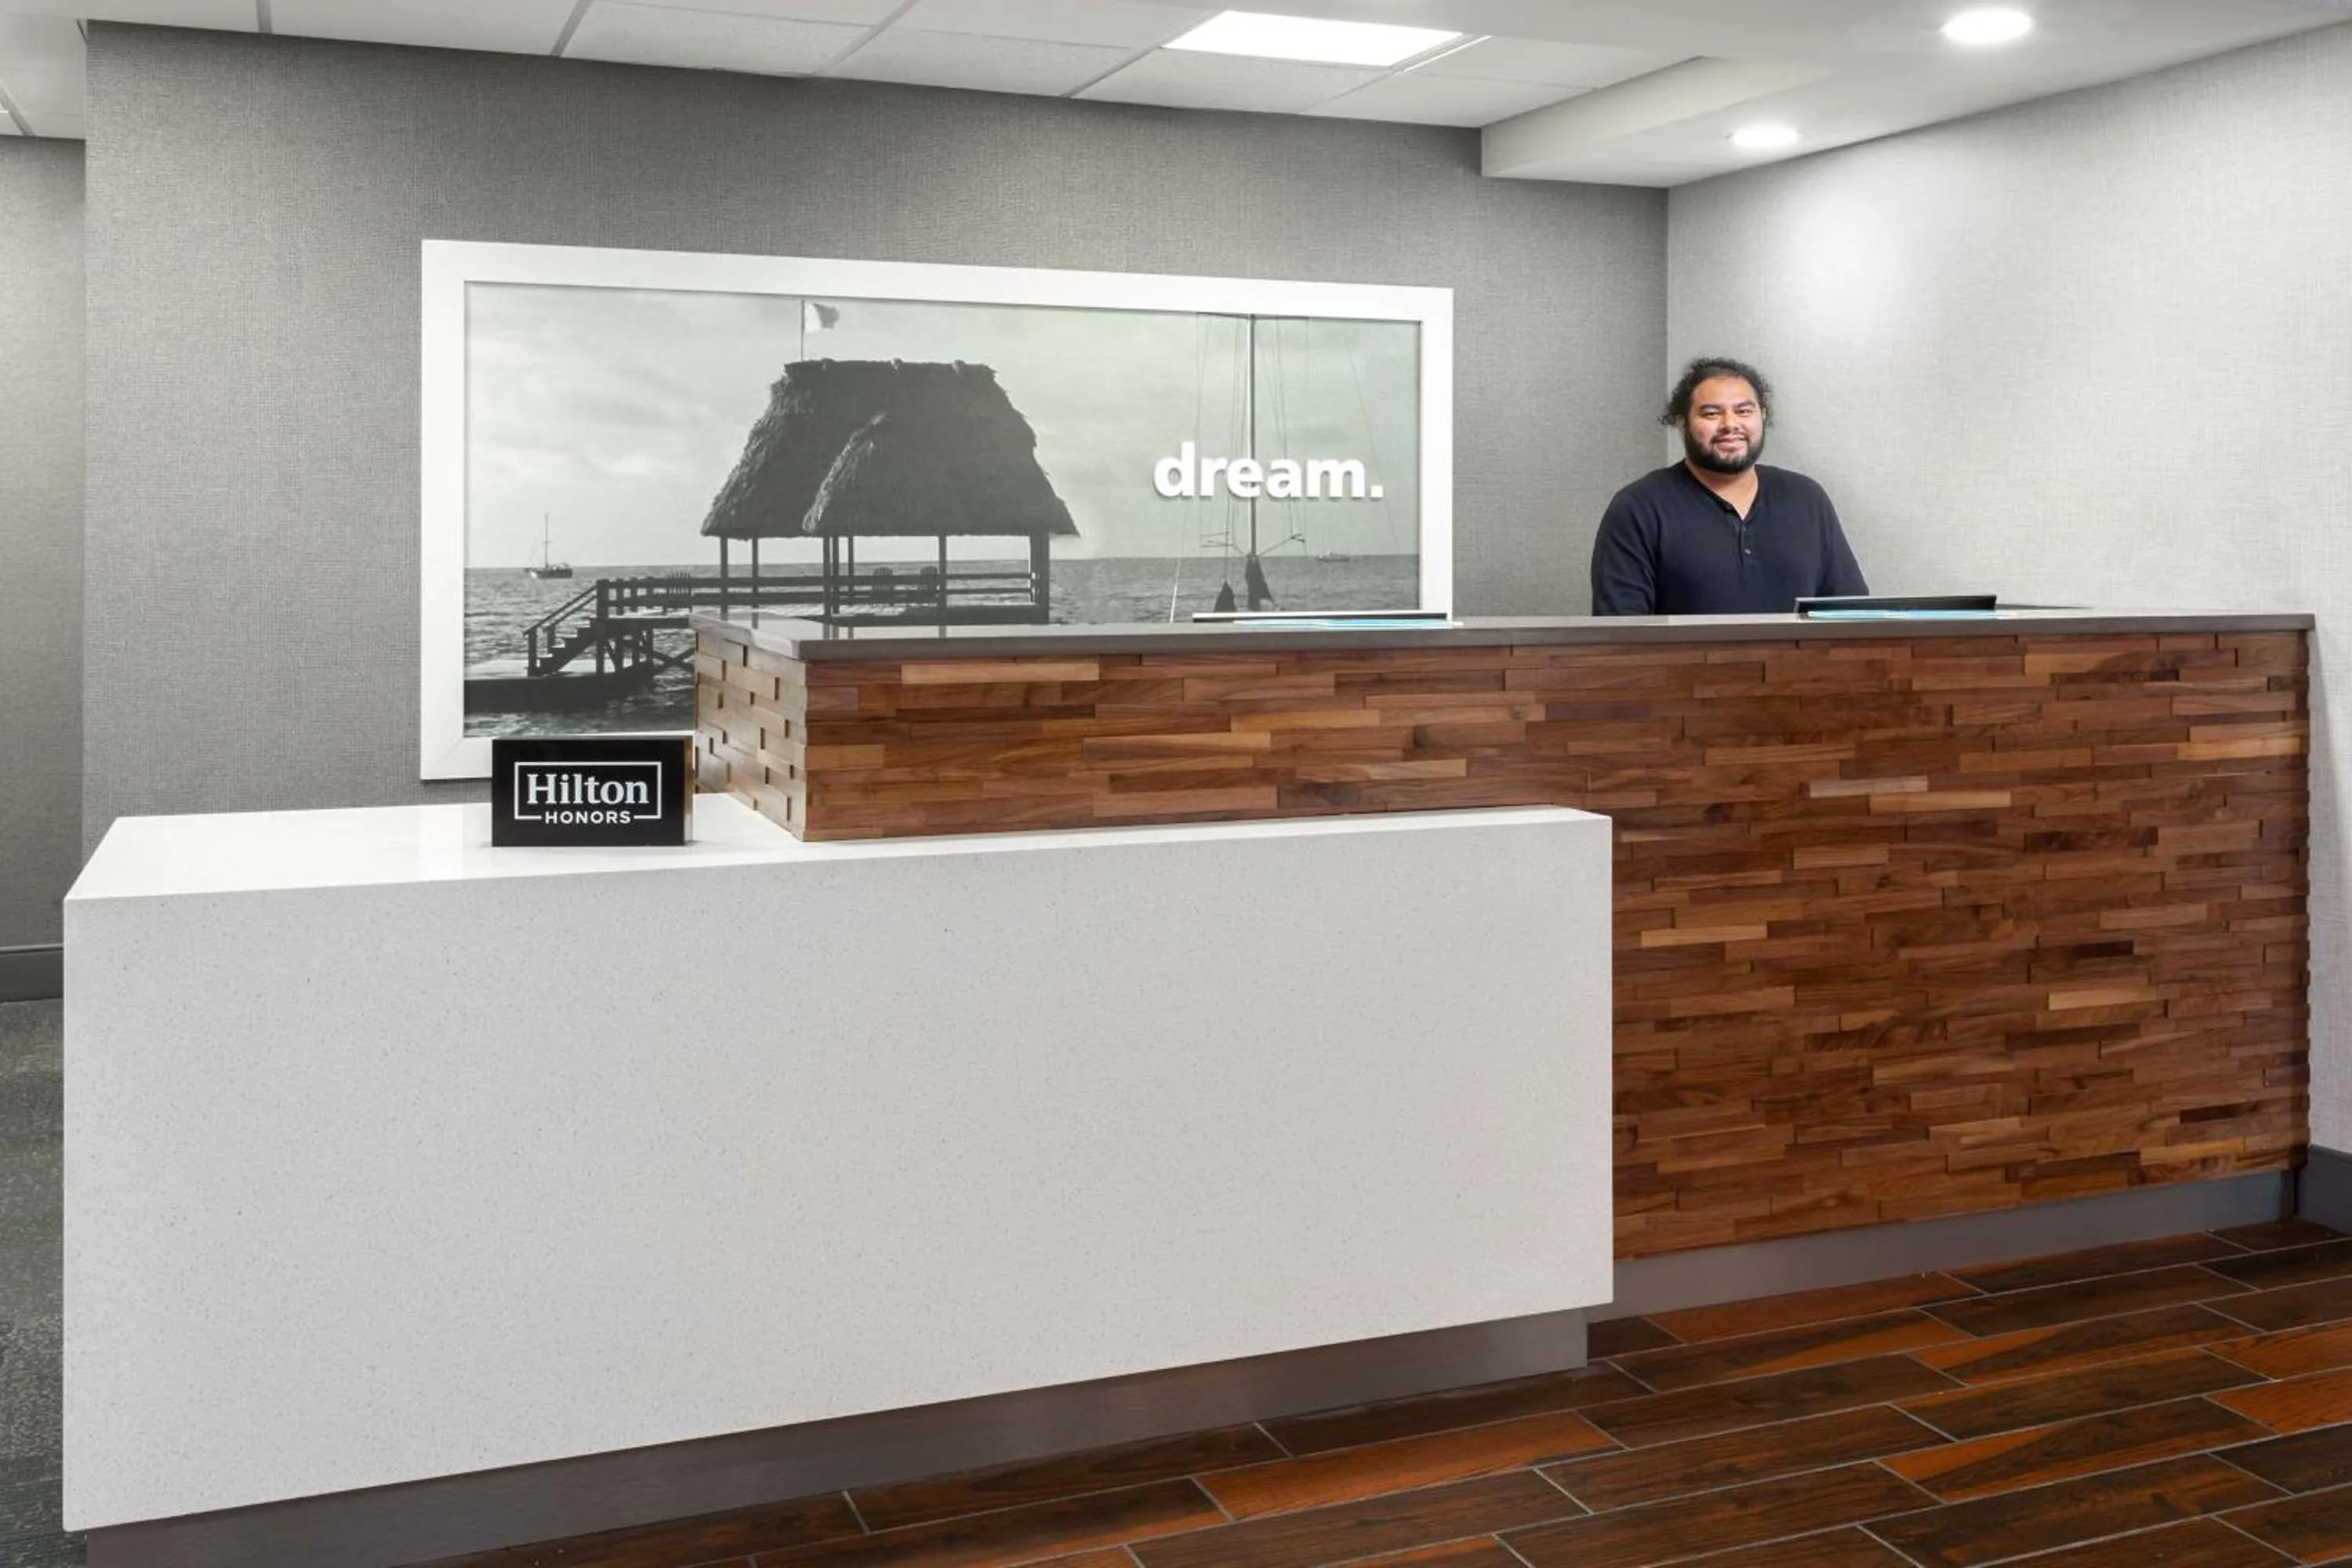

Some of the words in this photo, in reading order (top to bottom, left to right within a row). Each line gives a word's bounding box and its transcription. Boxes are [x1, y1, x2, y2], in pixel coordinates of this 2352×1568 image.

[1153, 441, 1384, 499] dream.
[526, 773, 649, 804] Hilton
[545, 811, 631, 824] HONORS
